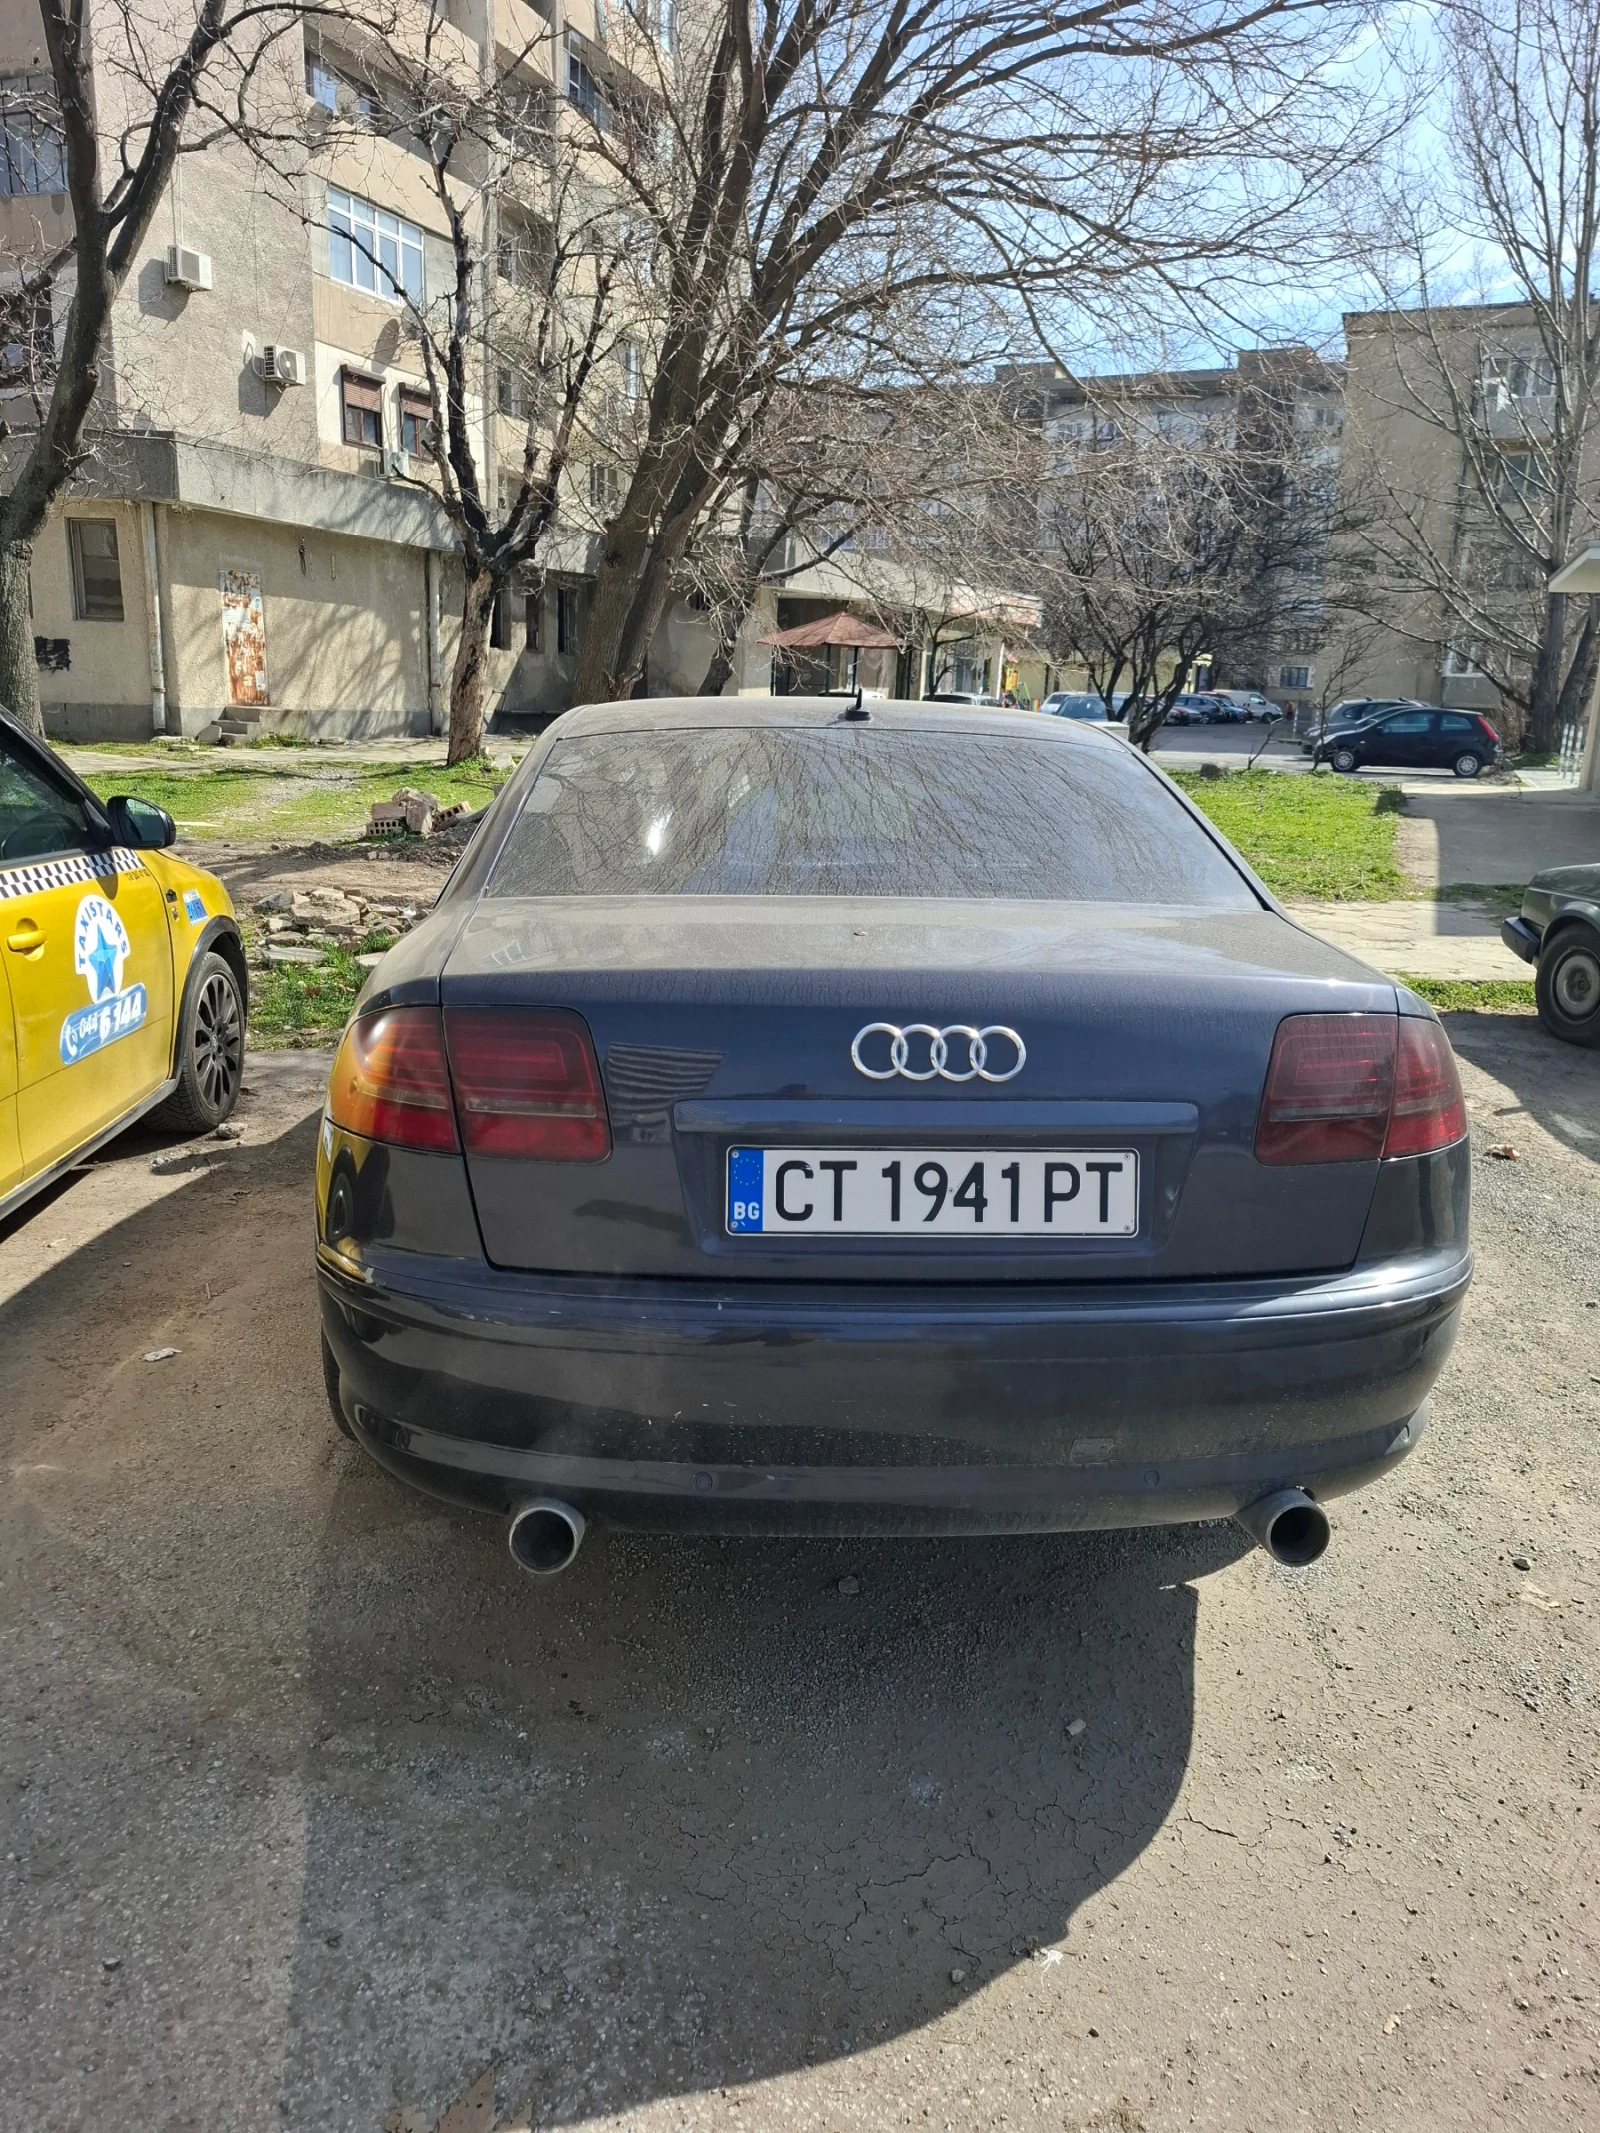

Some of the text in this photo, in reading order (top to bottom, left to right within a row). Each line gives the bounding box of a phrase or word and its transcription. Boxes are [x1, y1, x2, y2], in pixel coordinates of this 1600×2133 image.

[78, 901, 128, 969] TAXISTARS
[79, 1011, 98, 1039] 044
[734, 1201, 760, 1220] BG
[776, 1160, 1123, 1223] CT 1941 PT
